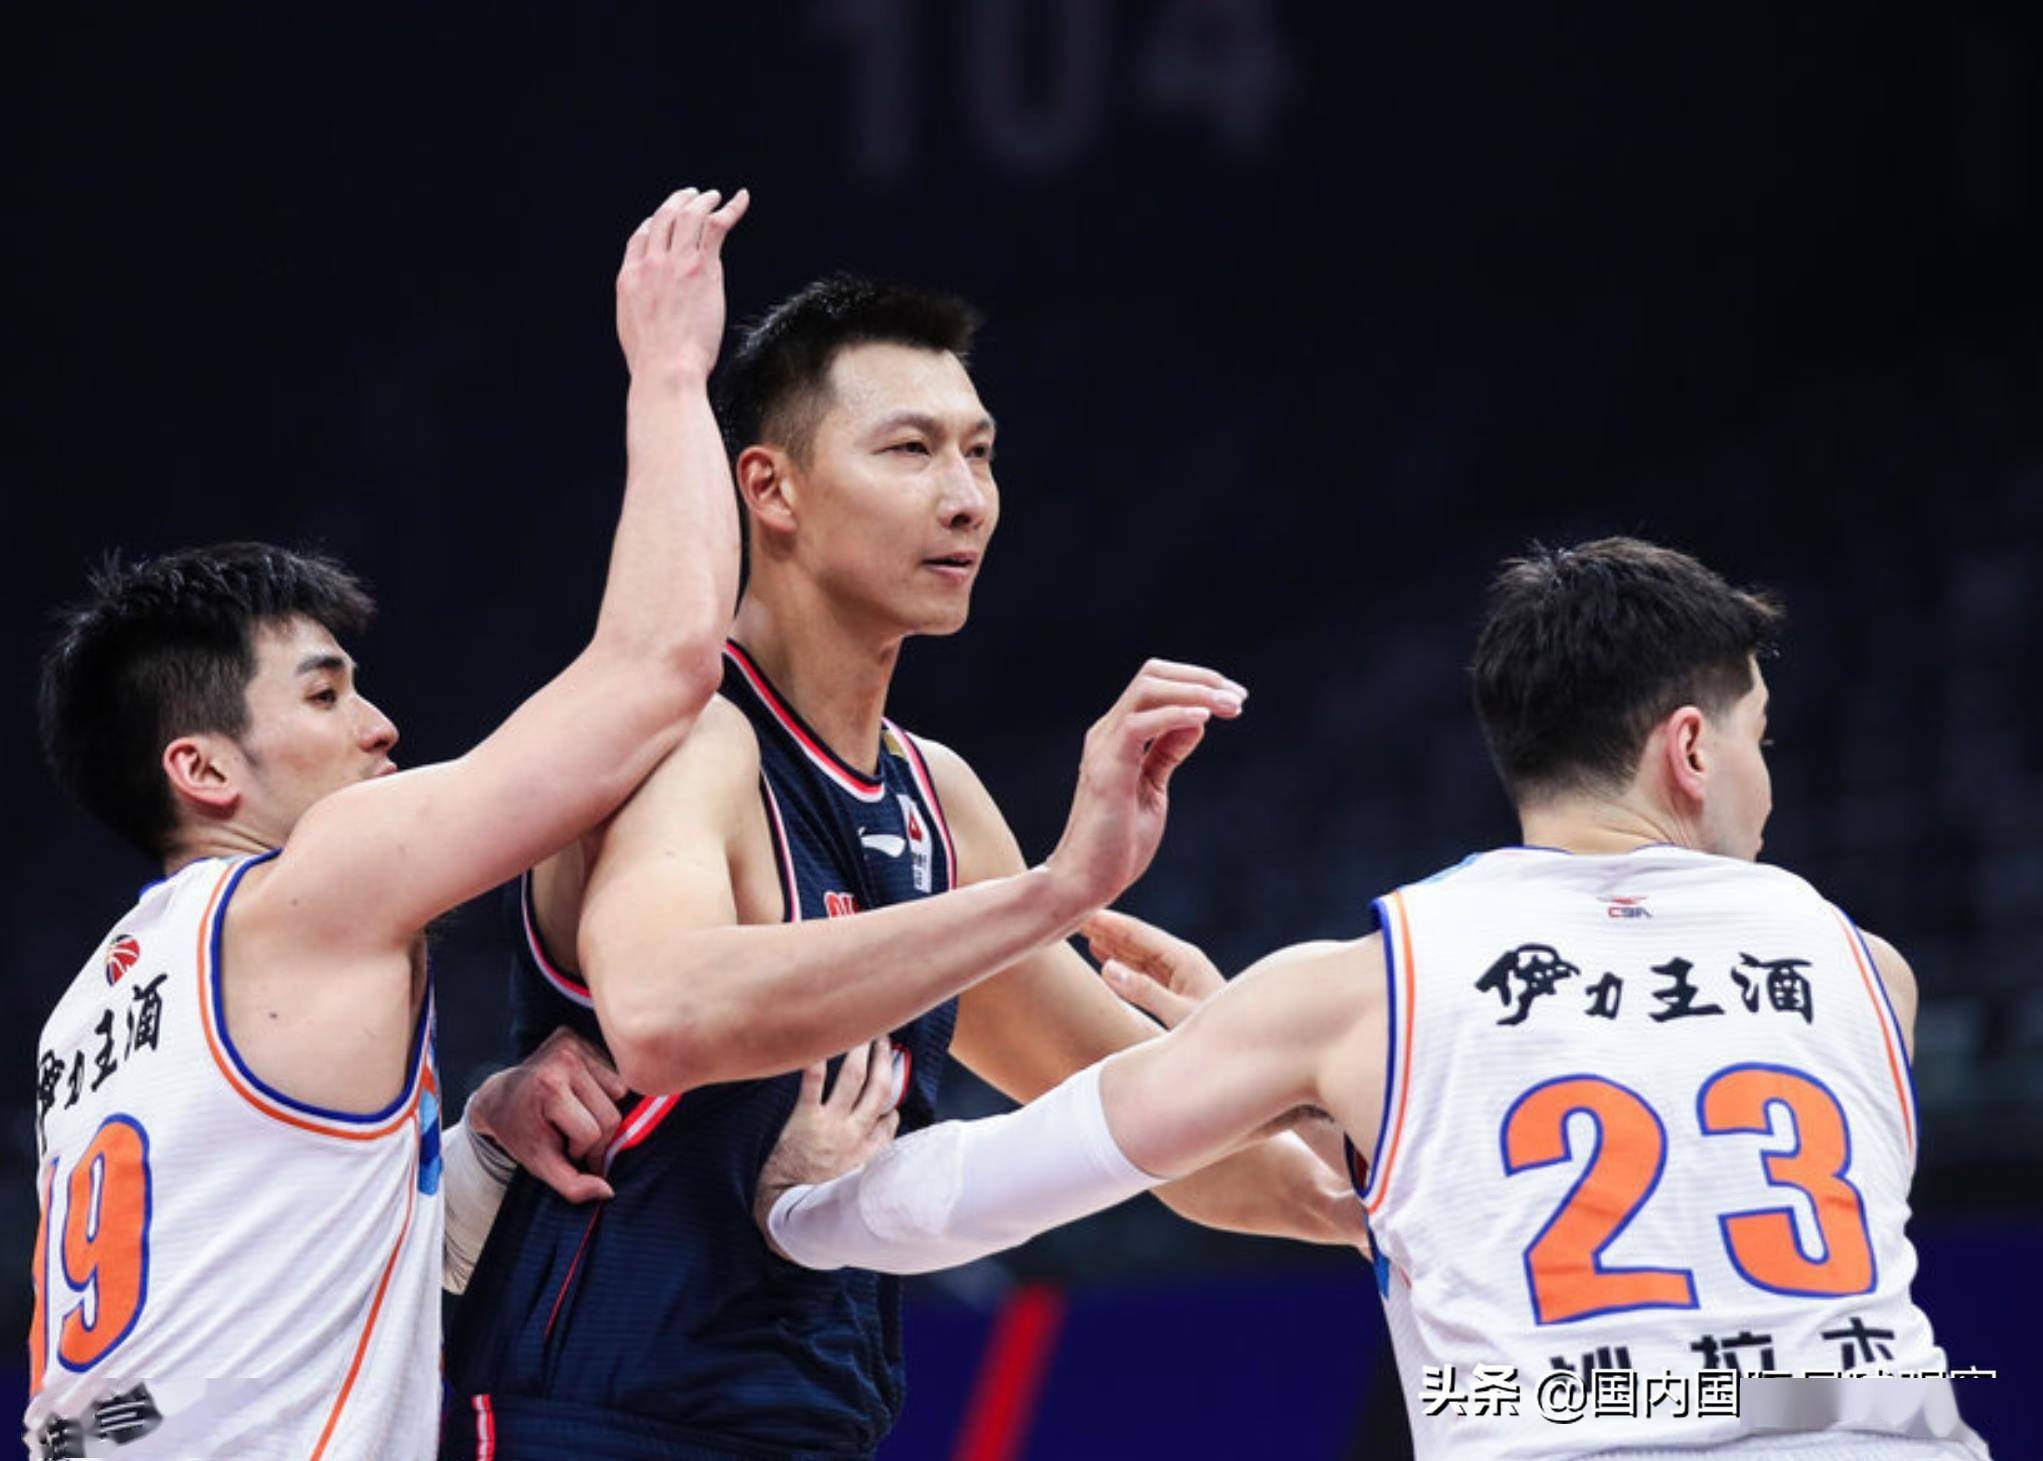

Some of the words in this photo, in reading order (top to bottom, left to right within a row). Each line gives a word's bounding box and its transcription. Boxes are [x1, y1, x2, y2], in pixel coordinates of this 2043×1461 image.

[1475, 943, 1816, 1026] 伊力王酒
[1499, 1061, 1877, 1327] 23
